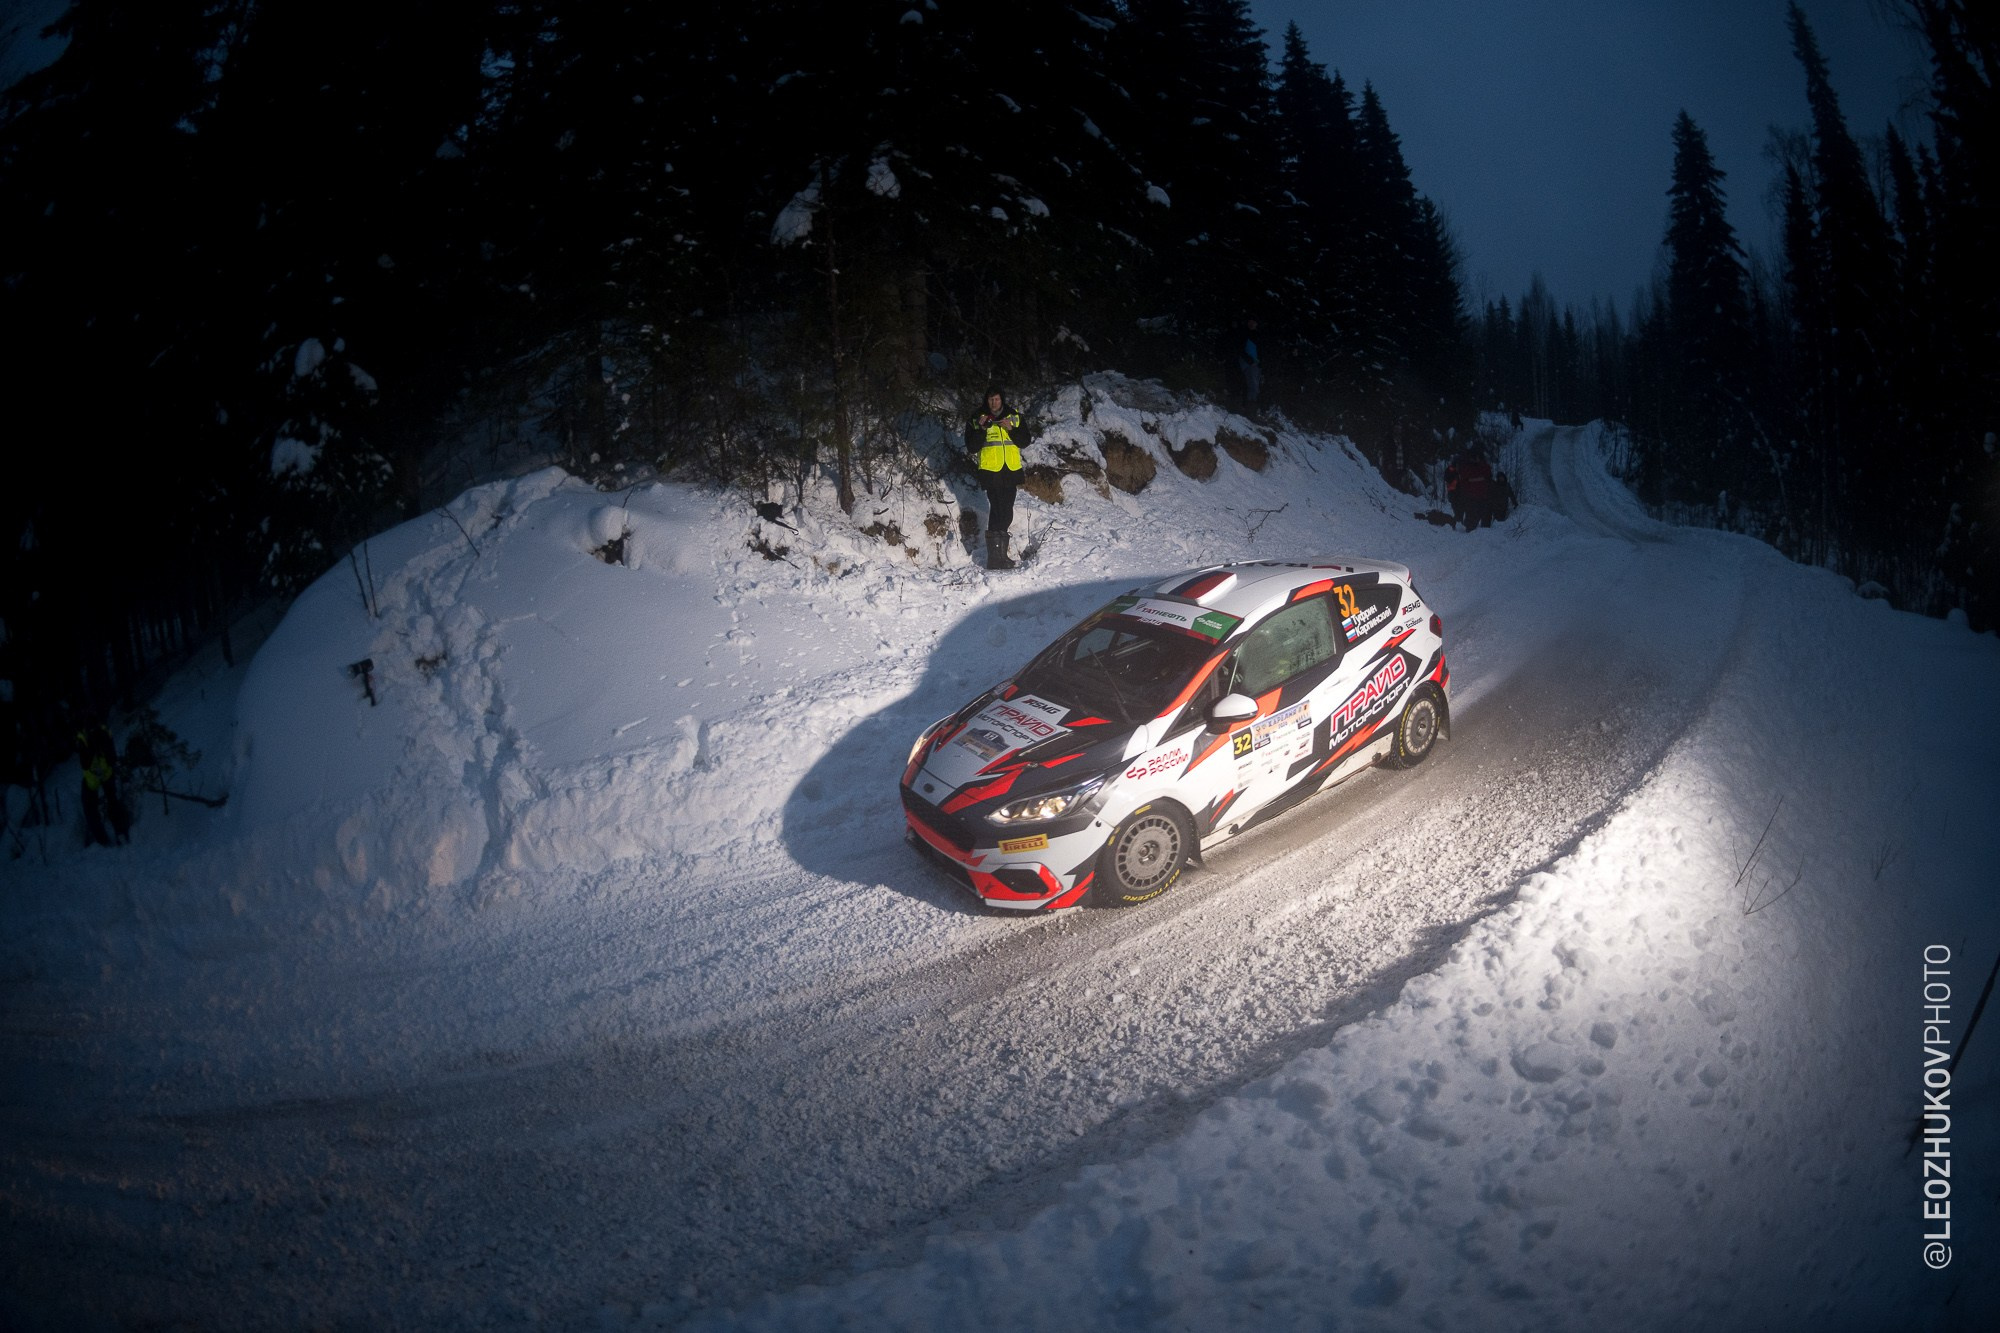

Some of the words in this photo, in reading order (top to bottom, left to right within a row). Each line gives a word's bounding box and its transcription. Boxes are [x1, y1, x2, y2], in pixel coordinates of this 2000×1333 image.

[1333, 584, 1360, 618] 32
[1142, 607, 1187, 622] ТАТНЕФТЬ
[1233, 733, 1252, 755] 32
[1002, 837, 1044, 851] PIRELLI
